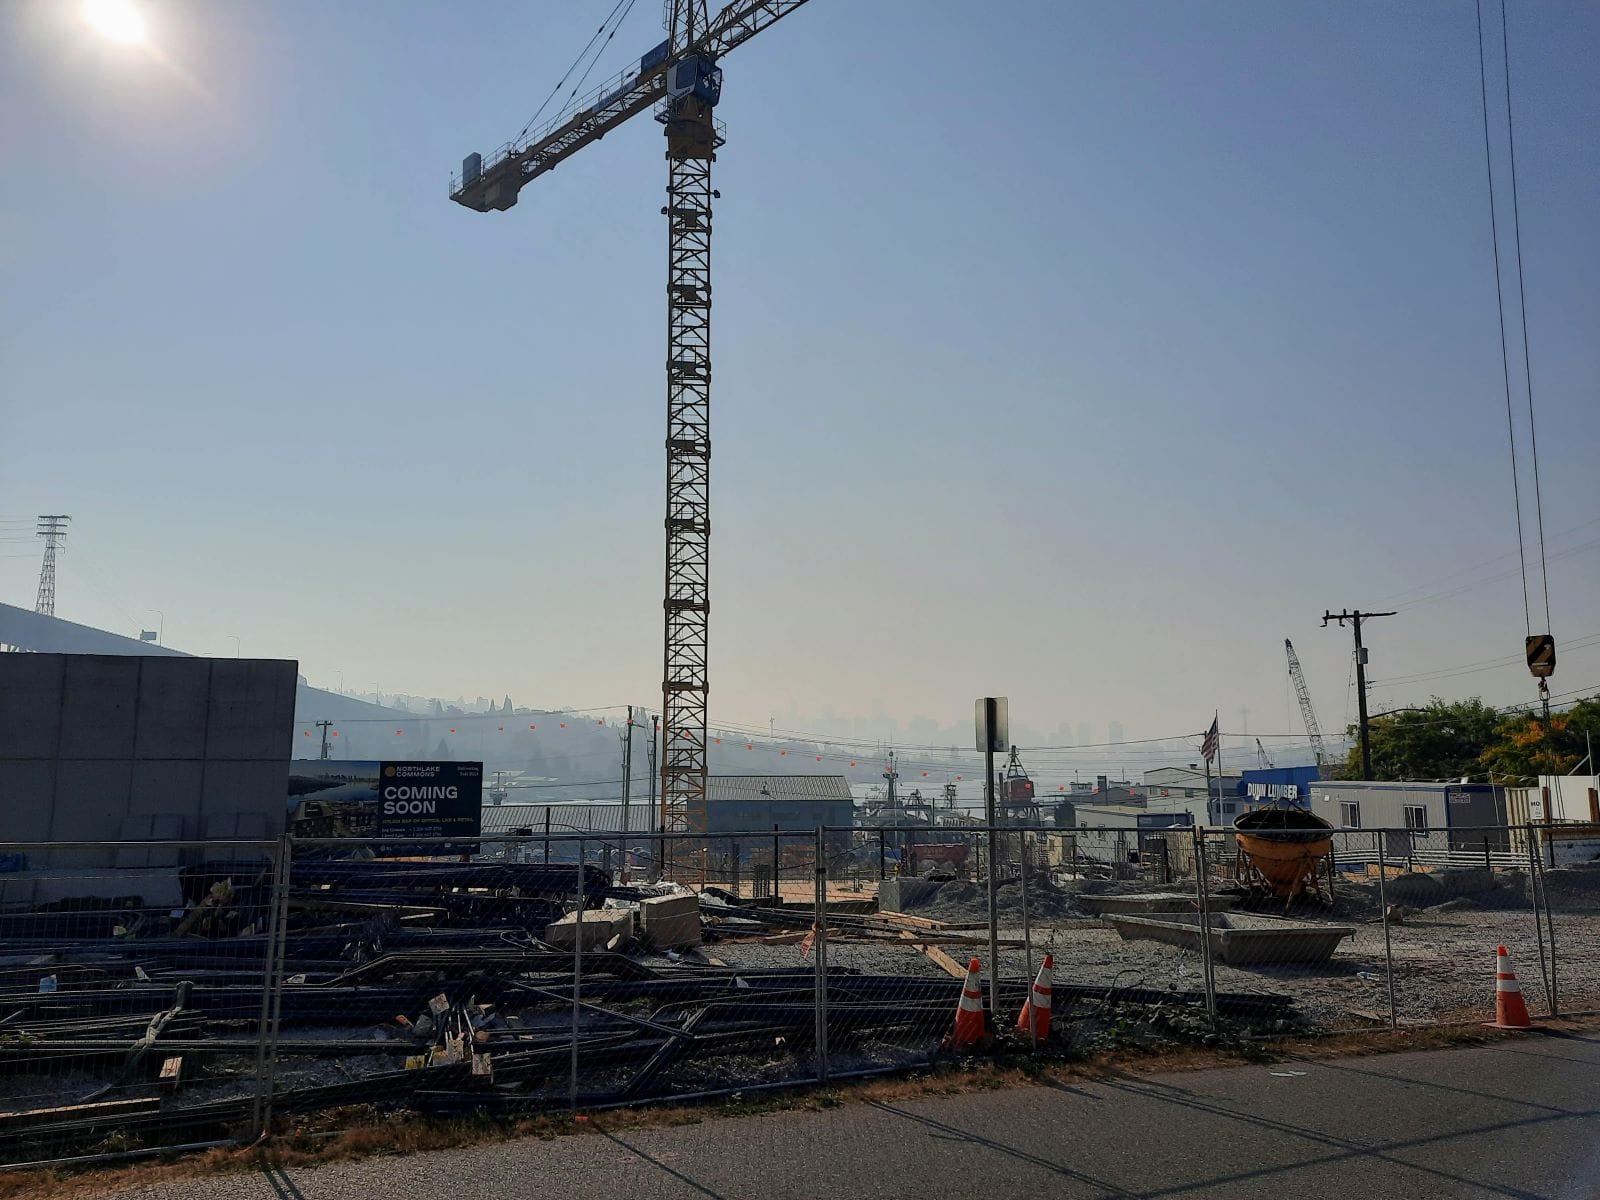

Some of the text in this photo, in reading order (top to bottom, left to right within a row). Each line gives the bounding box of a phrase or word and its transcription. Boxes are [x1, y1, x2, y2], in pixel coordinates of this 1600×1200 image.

[384, 786, 458, 799] COMING
[1267, 784, 1297, 799] LUMBER
[384, 801, 436, 815] SOON
